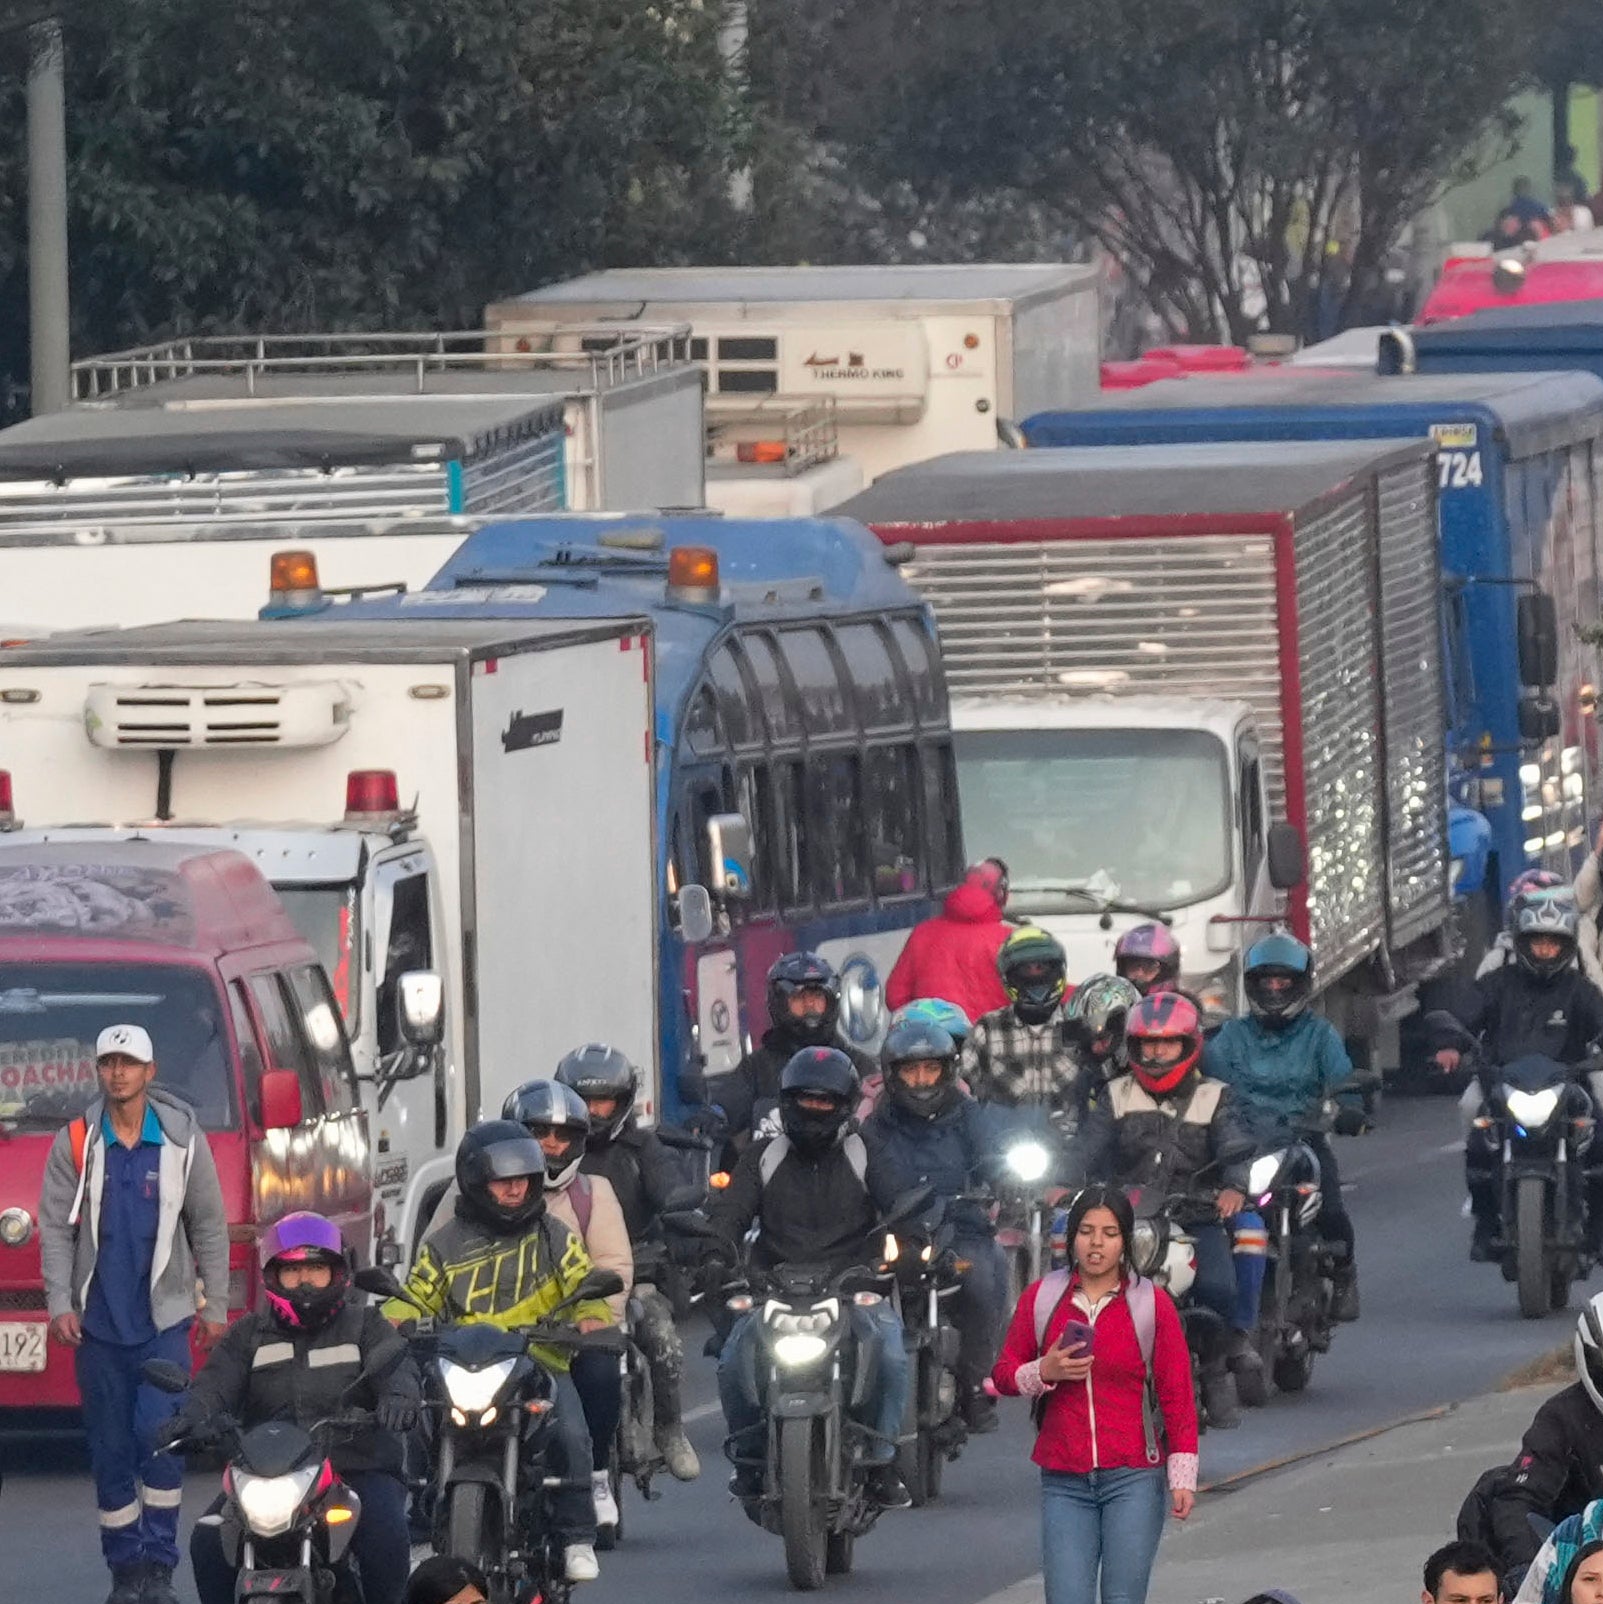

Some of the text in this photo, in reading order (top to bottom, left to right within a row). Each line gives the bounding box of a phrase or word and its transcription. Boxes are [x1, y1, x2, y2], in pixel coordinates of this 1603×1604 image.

[814, 368, 905, 380] THERMO KING
[1436, 451, 1483, 488] 724
[0, 1060, 95, 1088] OACHA
[2, 1332, 43, 1358] 192
